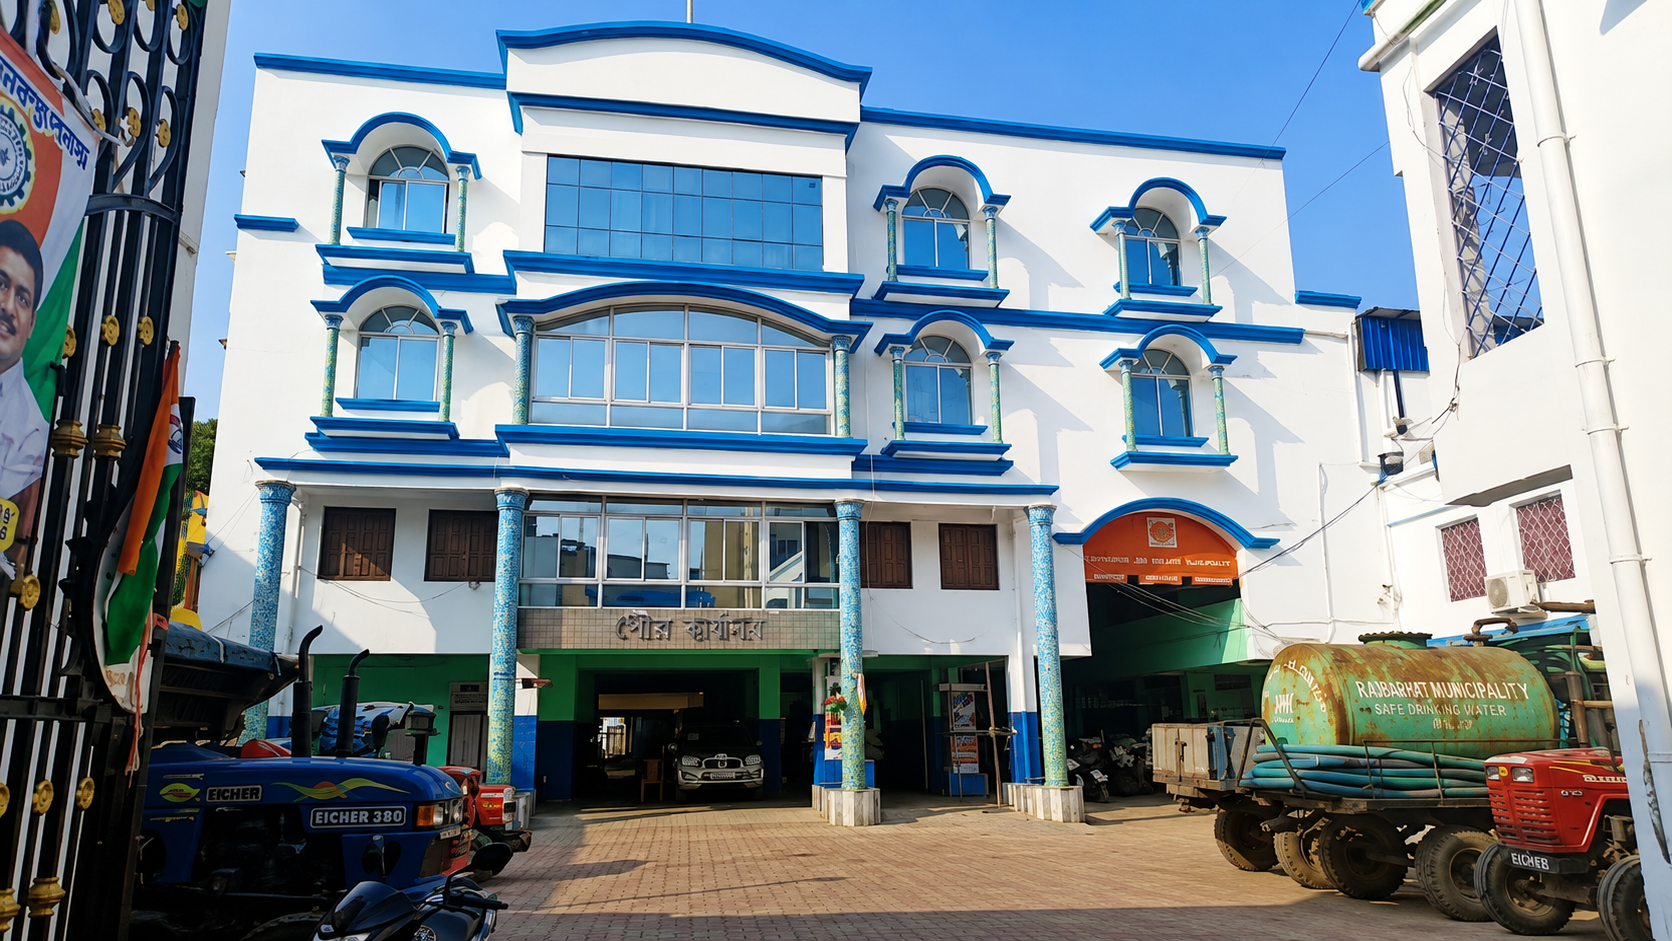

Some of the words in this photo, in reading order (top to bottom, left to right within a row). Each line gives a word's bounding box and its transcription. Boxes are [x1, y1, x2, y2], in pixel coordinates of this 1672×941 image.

[1430, 681, 1530, 700] MUNICIPALITY
[1374, 703, 1405, 716] SAFE
[1408, 703, 1461, 716] DRINKING
[1464, 704, 1507, 717] WATER
[207, 787, 260, 801] EICHER
[315, 811, 369, 824] EICHER
[372, 810, 403, 823] 380
